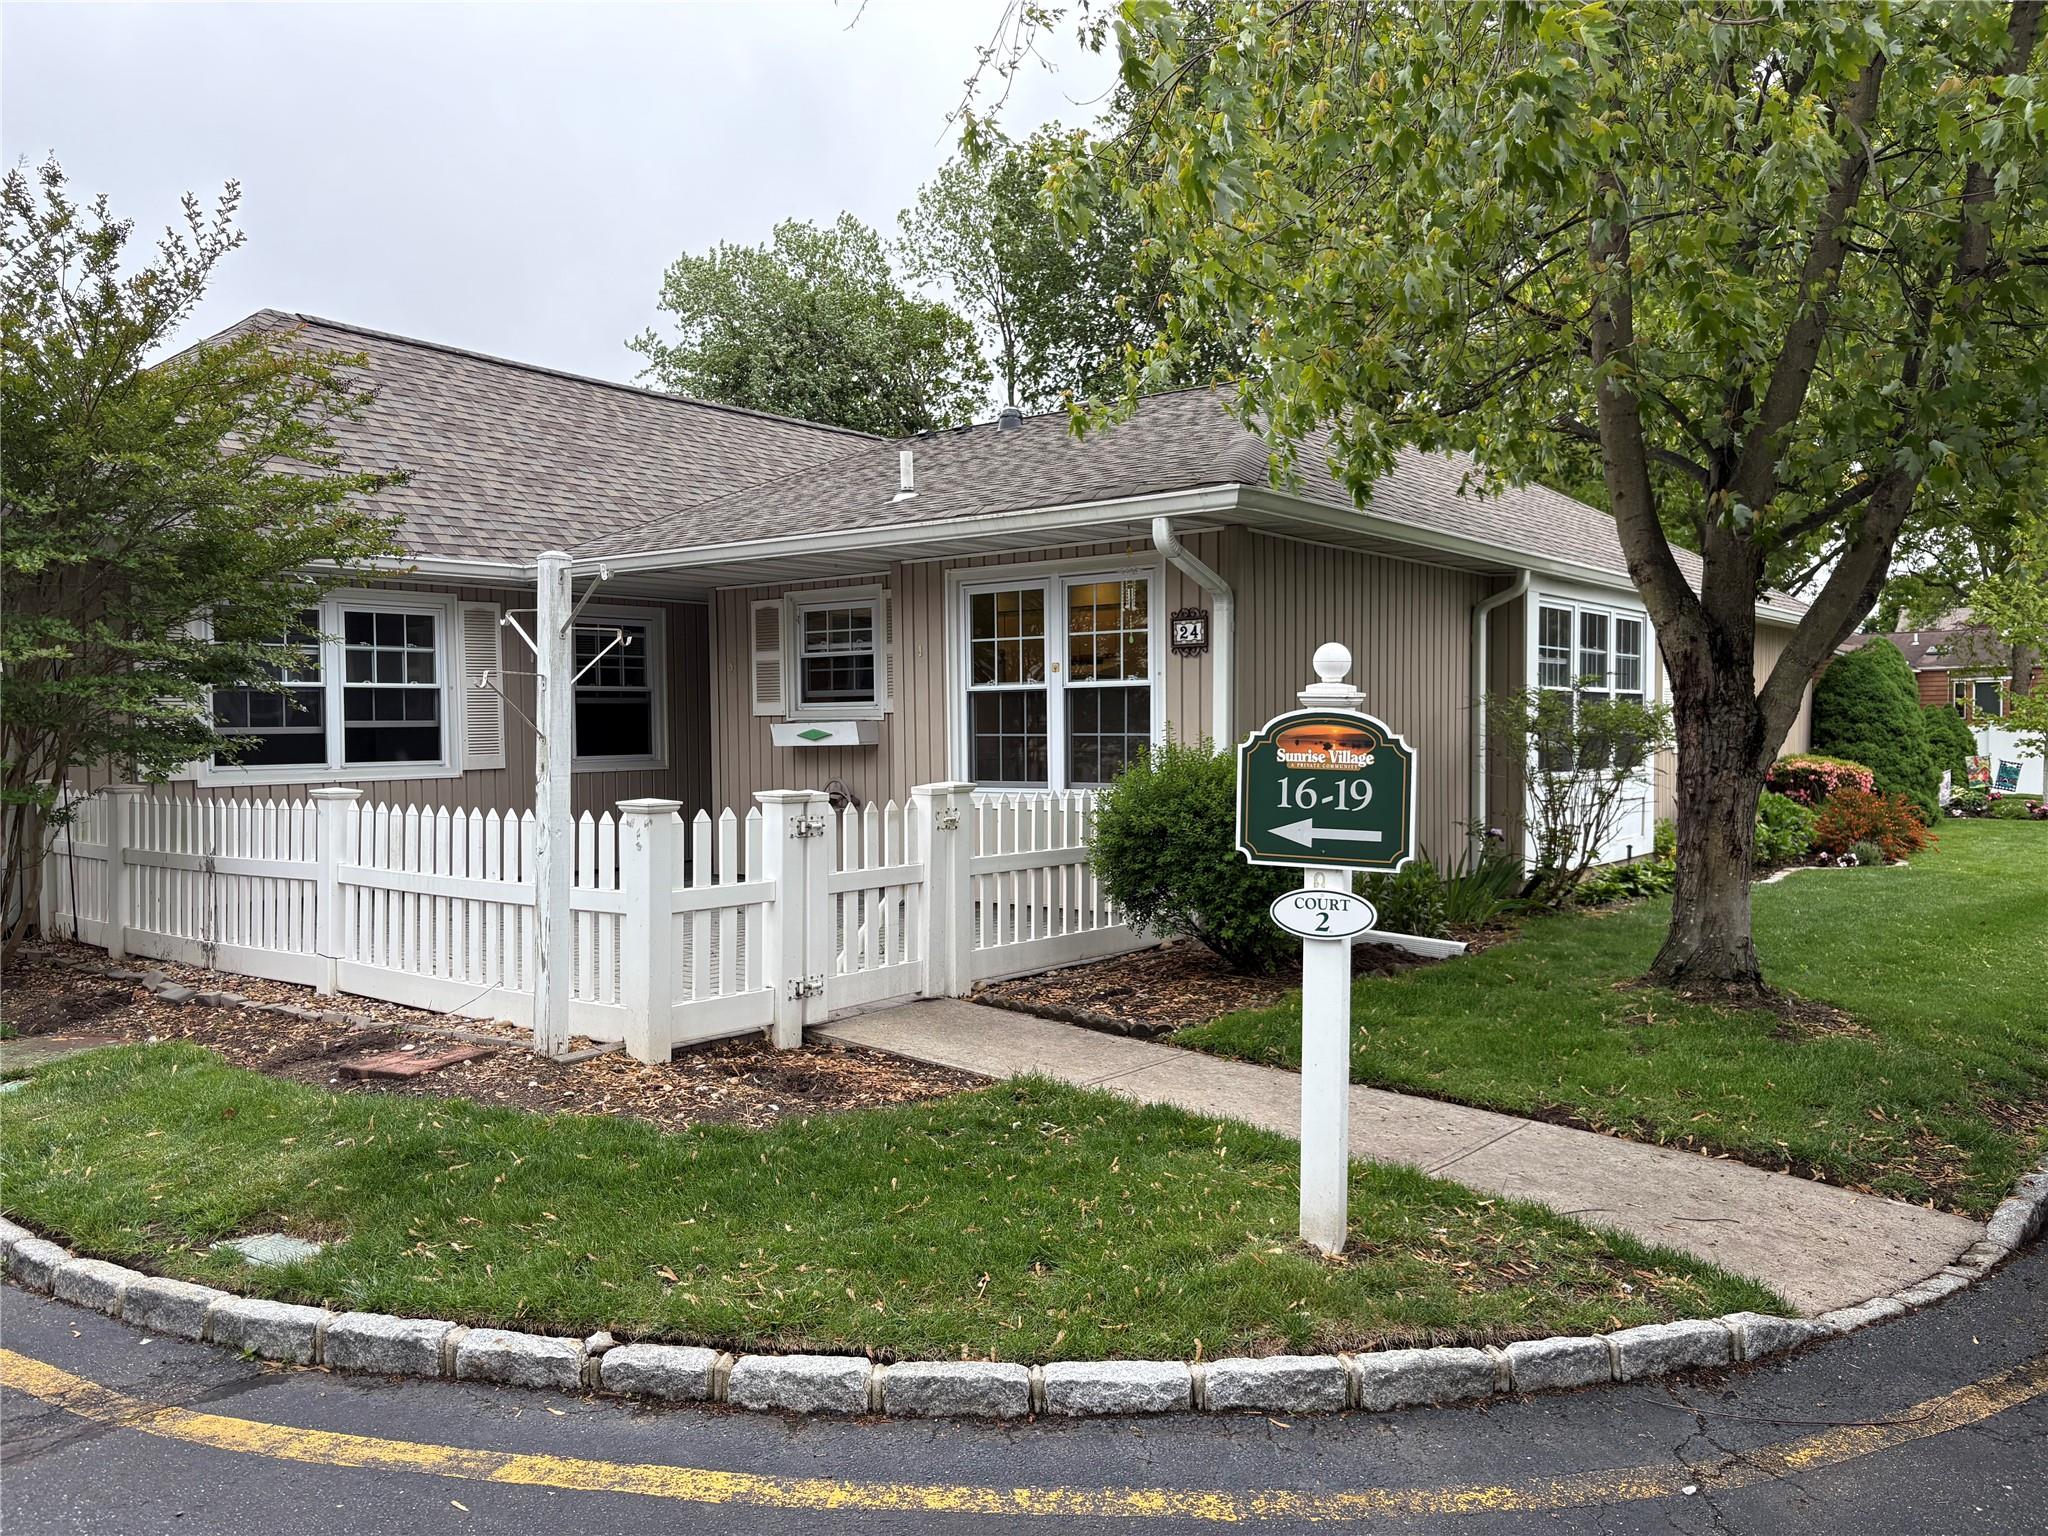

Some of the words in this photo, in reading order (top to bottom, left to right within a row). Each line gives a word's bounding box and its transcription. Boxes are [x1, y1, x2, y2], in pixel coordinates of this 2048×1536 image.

[1180, 625, 1198, 640] 24
[1276, 748, 1326, 763] Sunrise
[1328, 749, 1375, 767] Village
[1276, 776, 1373, 812] 16-19
[1294, 897, 1351, 911] COURT
[1315, 911, 1330, 932] 2
